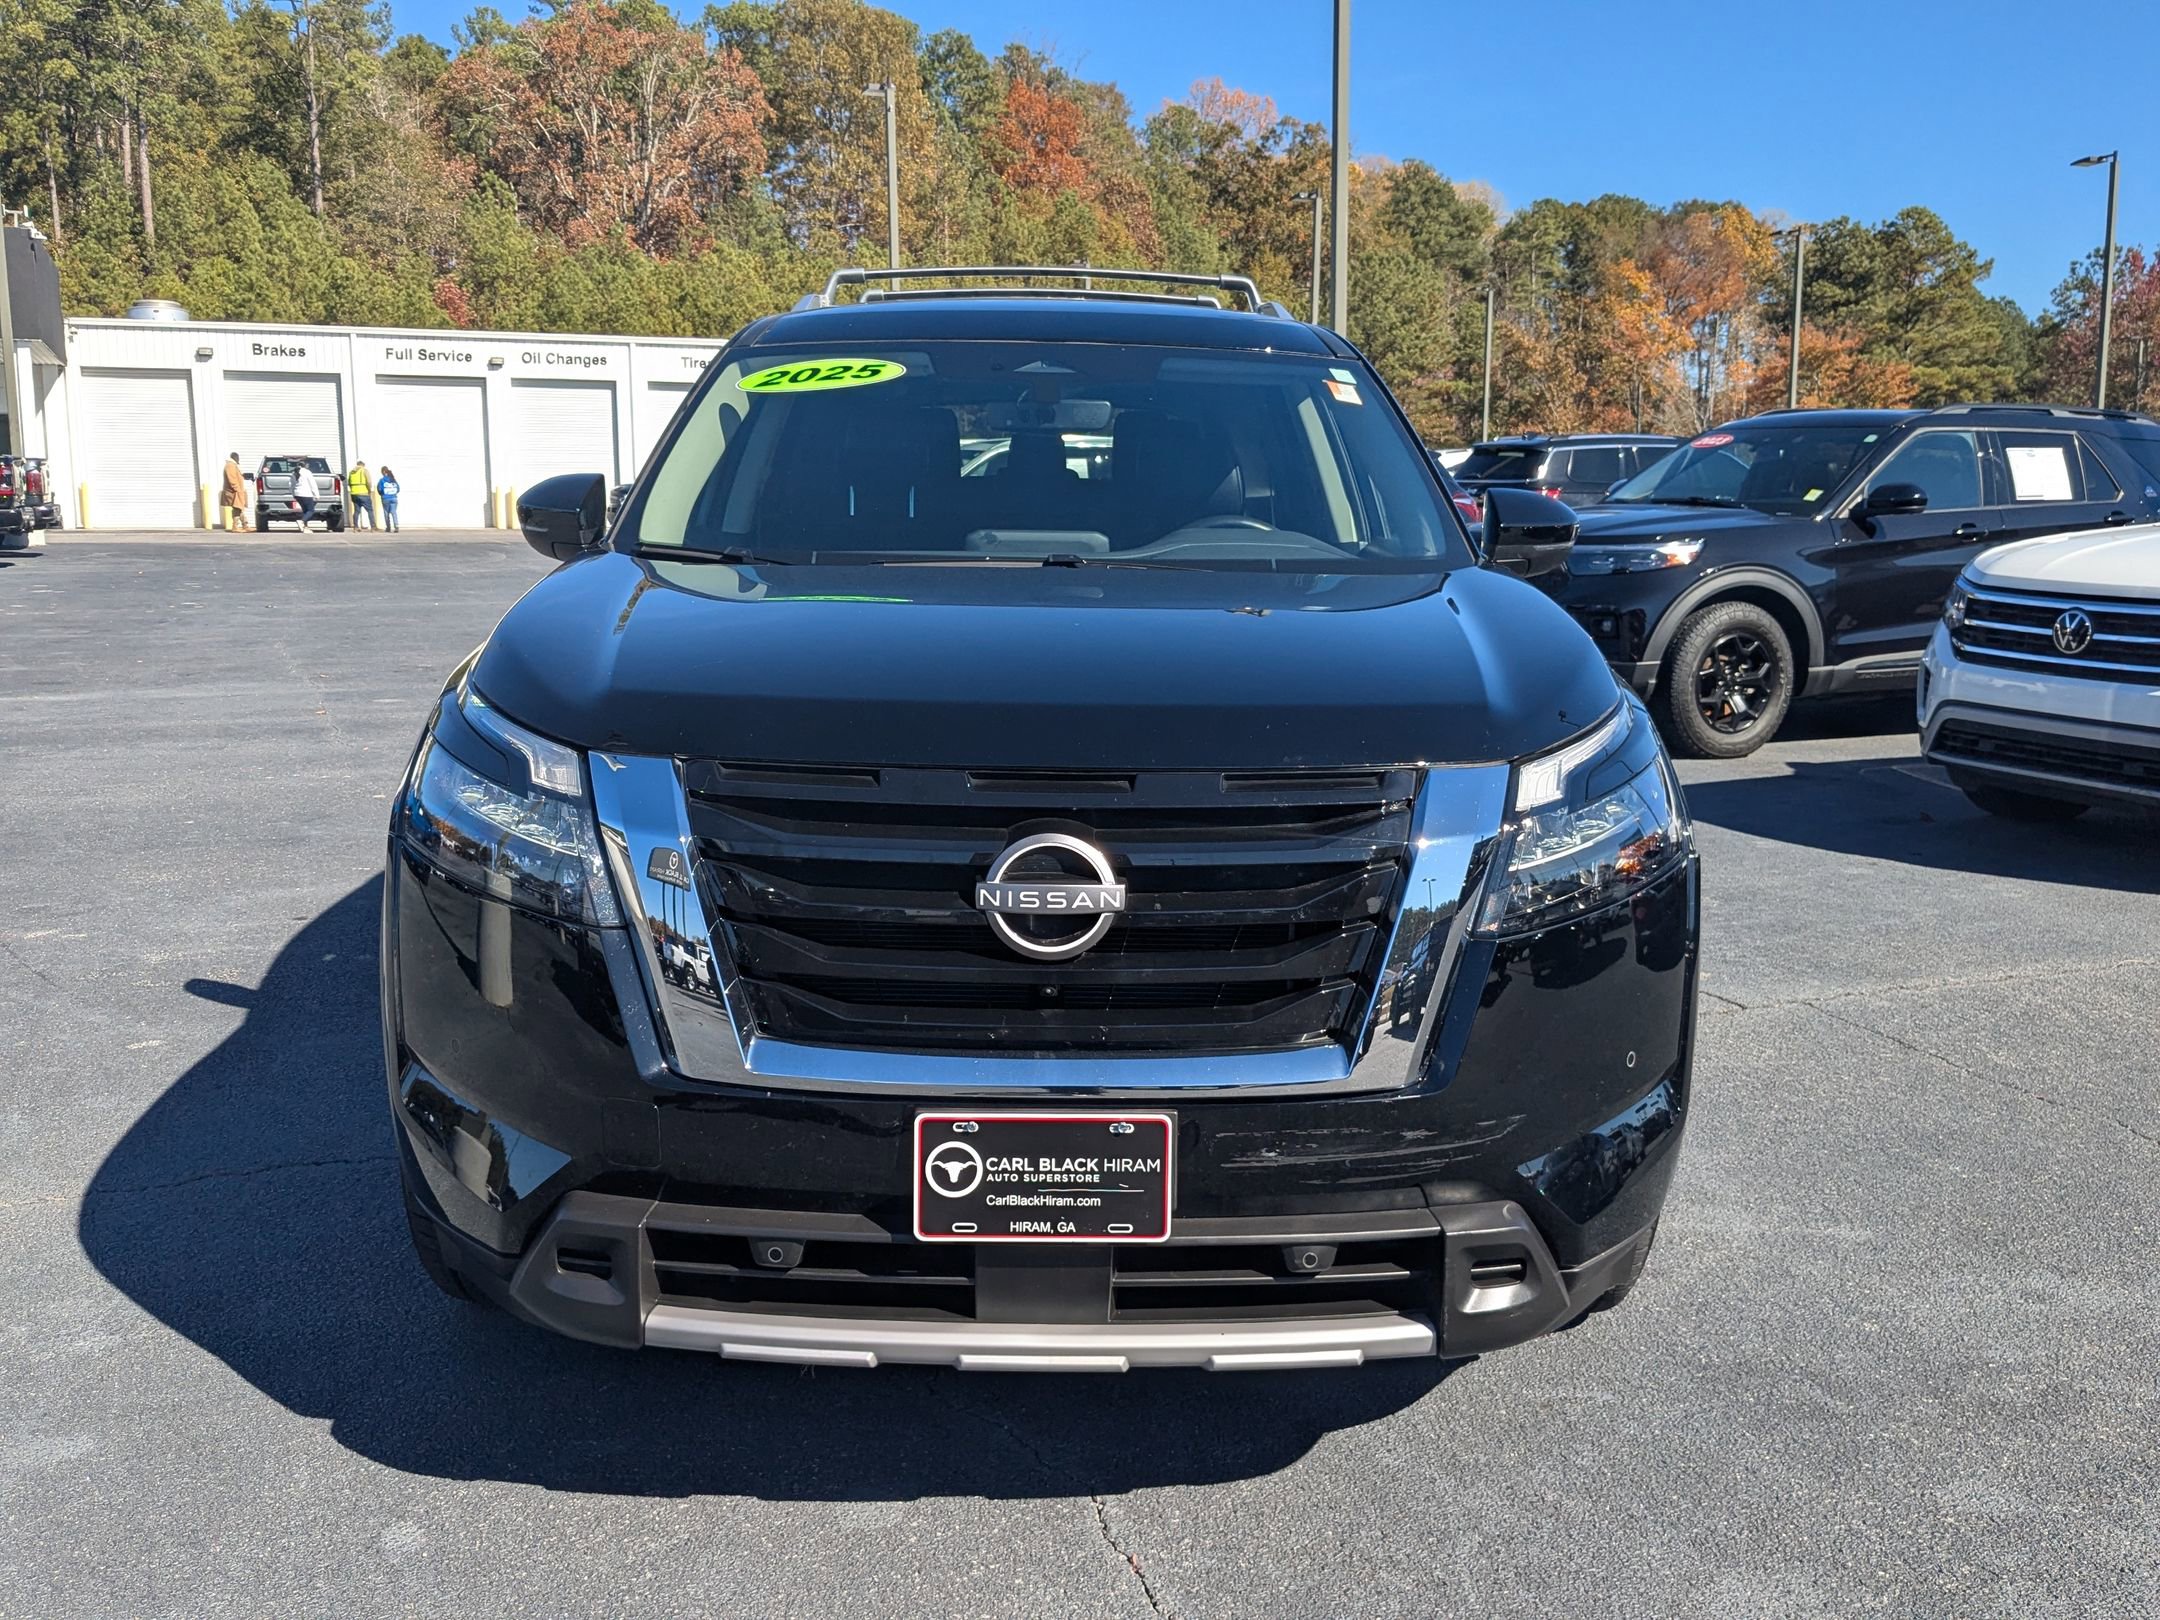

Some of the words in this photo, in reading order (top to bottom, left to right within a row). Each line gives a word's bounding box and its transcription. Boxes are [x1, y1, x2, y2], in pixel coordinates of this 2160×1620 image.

[252, 343, 306, 357] Brakes
[386, 348, 412, 360] Full
[418, 349, 472, 362] Service
[521, 352, 541, 364] Oil
[546, 353, 607, 367] Changes
[681, 357, 711, 368] Tire
[753, 364, 887, 388] 2025
[979, 889, 1121, 909] NISSAN
[986, 1157, 1034, 1172] CARL
[1039, 1157, 1099, 1172] BLACK
[1103, 1158, 1161, 1173] HIRAM
[986, 1173, 1019, 1182] AUTO
[1023, 1173, 1100, 1183] SUPERSTORE
[986, 1194, 1101, 1207] CarlBlackHiram.com
[1009, 1221, 1054, 1234] HIRAM,
[1058, 1221, 1076, 1233] GA
